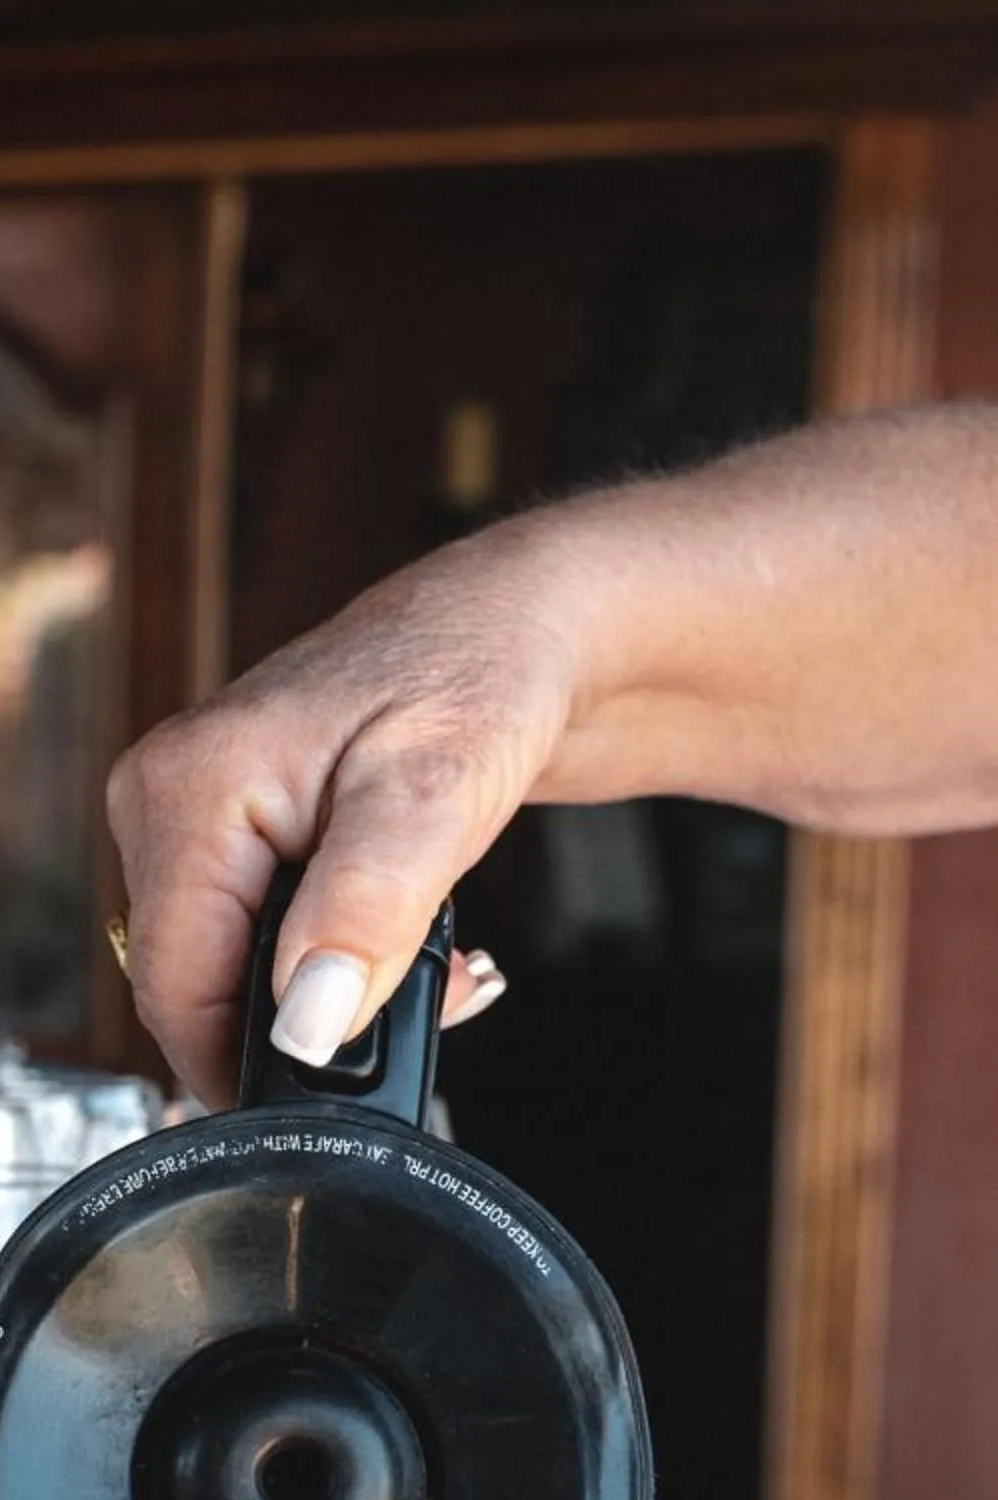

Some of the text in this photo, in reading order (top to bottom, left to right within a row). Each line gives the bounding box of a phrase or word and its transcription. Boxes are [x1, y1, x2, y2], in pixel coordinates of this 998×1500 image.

[262, 1134, 302, 1152] WITH
[429, 1167, 461, 1195] HOT
[457, 1184, 513, 1232] COFFEE
[505, 1221, 545, 1261] KEEP
